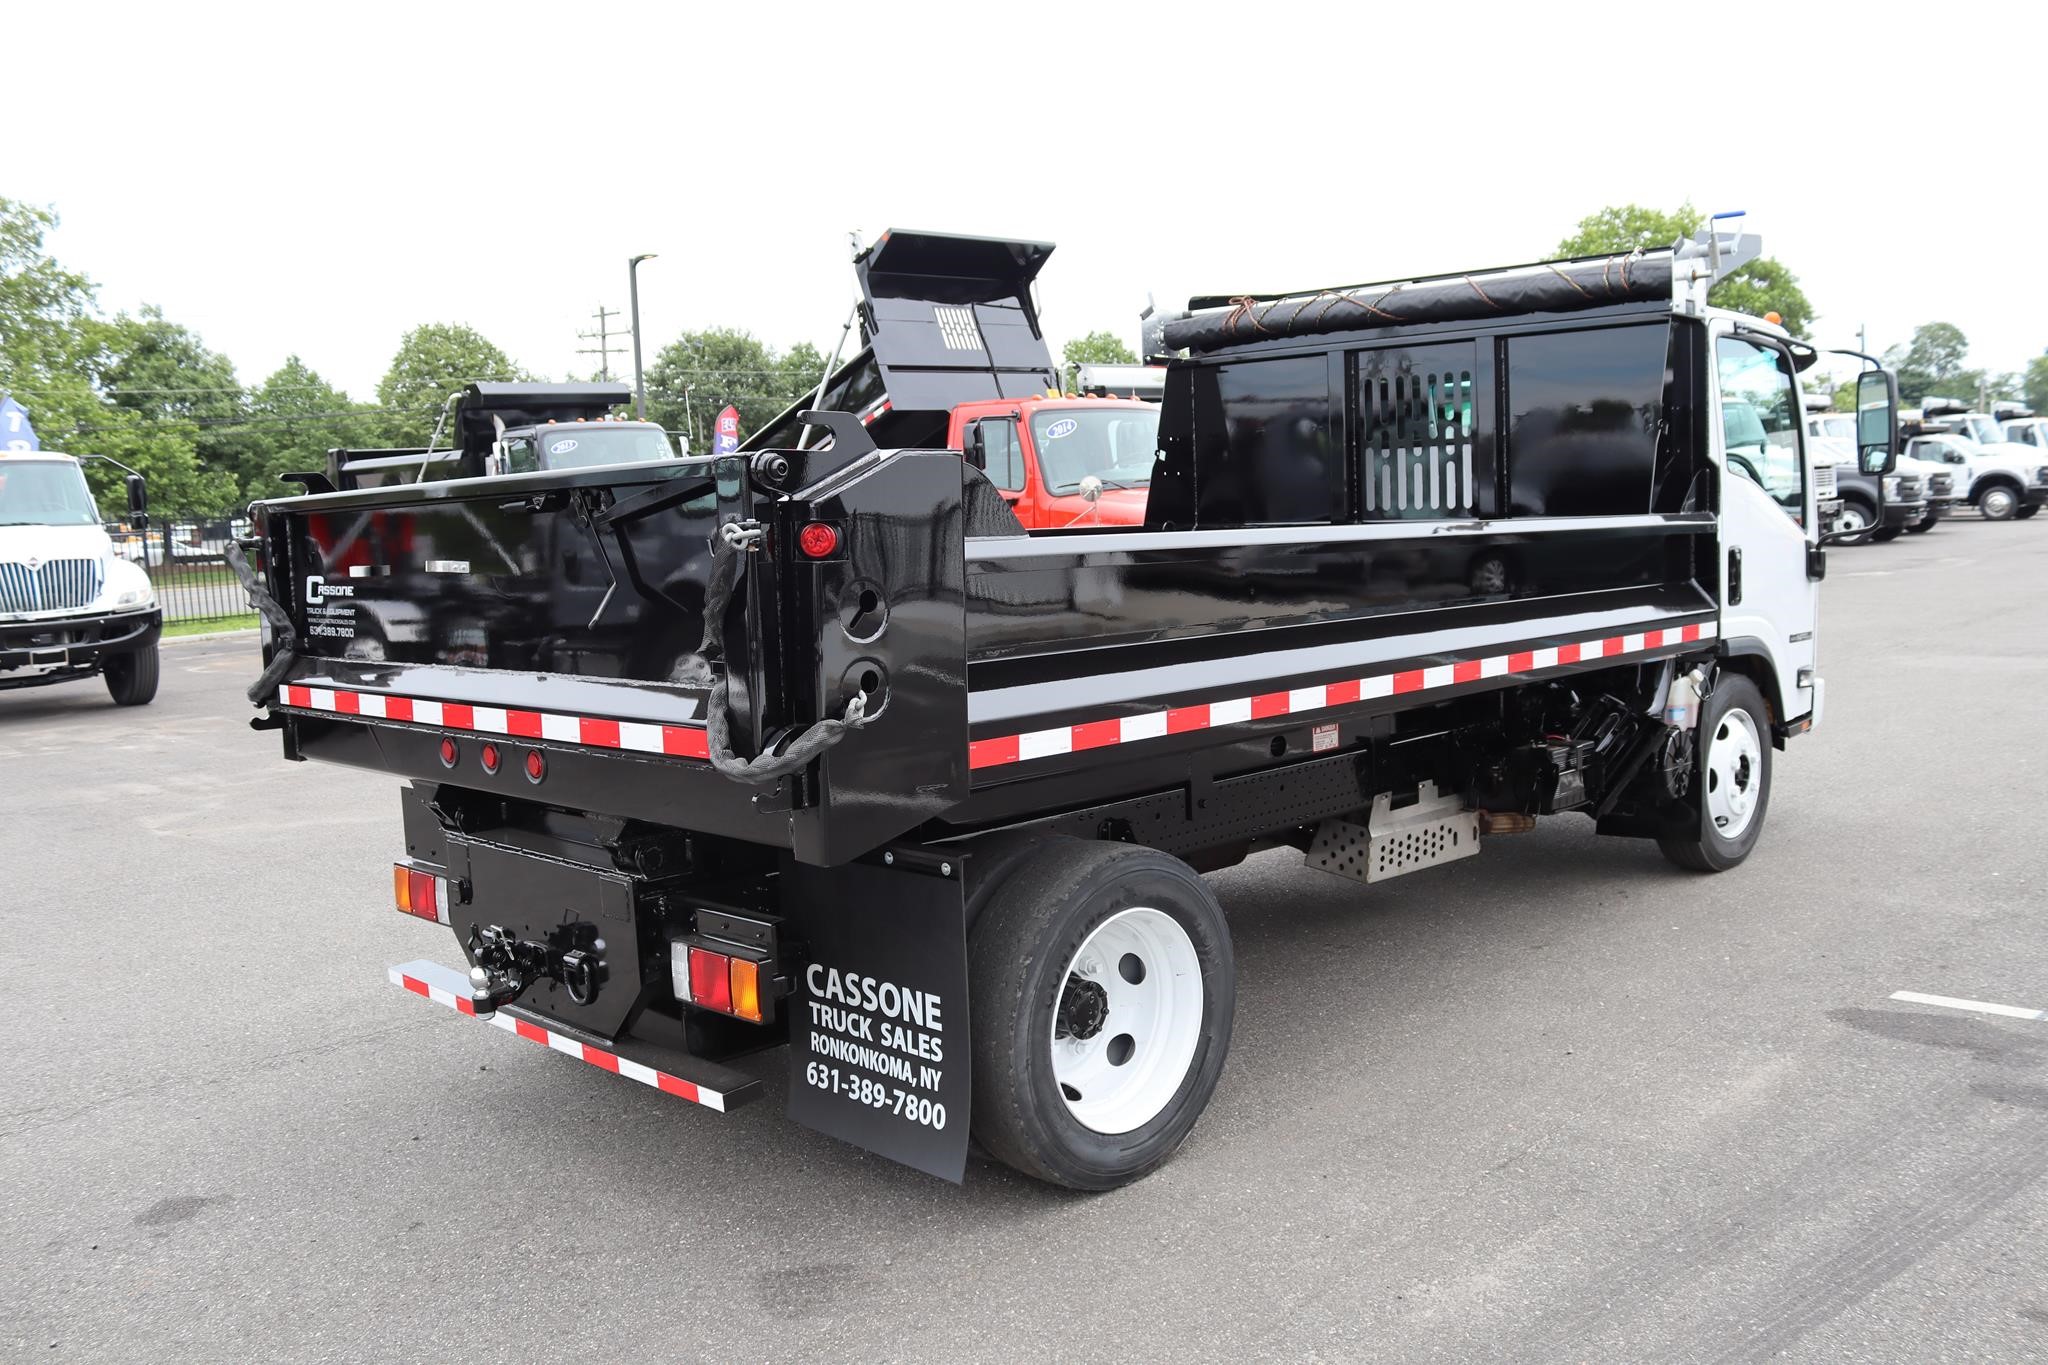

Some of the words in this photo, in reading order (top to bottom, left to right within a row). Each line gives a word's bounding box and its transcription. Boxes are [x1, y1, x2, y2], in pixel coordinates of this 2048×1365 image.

[306, 575, 354, 604] CASSONE
[306, 607, 322, 615] TRUCK
[806, 963, 943, 1032] CASSONE
[808, 1000, 873, 1042] TRUCK
[880, 1022, 943, 1063] SALES
[810, 1031, 917, 1087] RONKONKOMA,
[920, 1065, 943, 1092] NY
[806, 1061, 946, 1130] 631-389-7800
